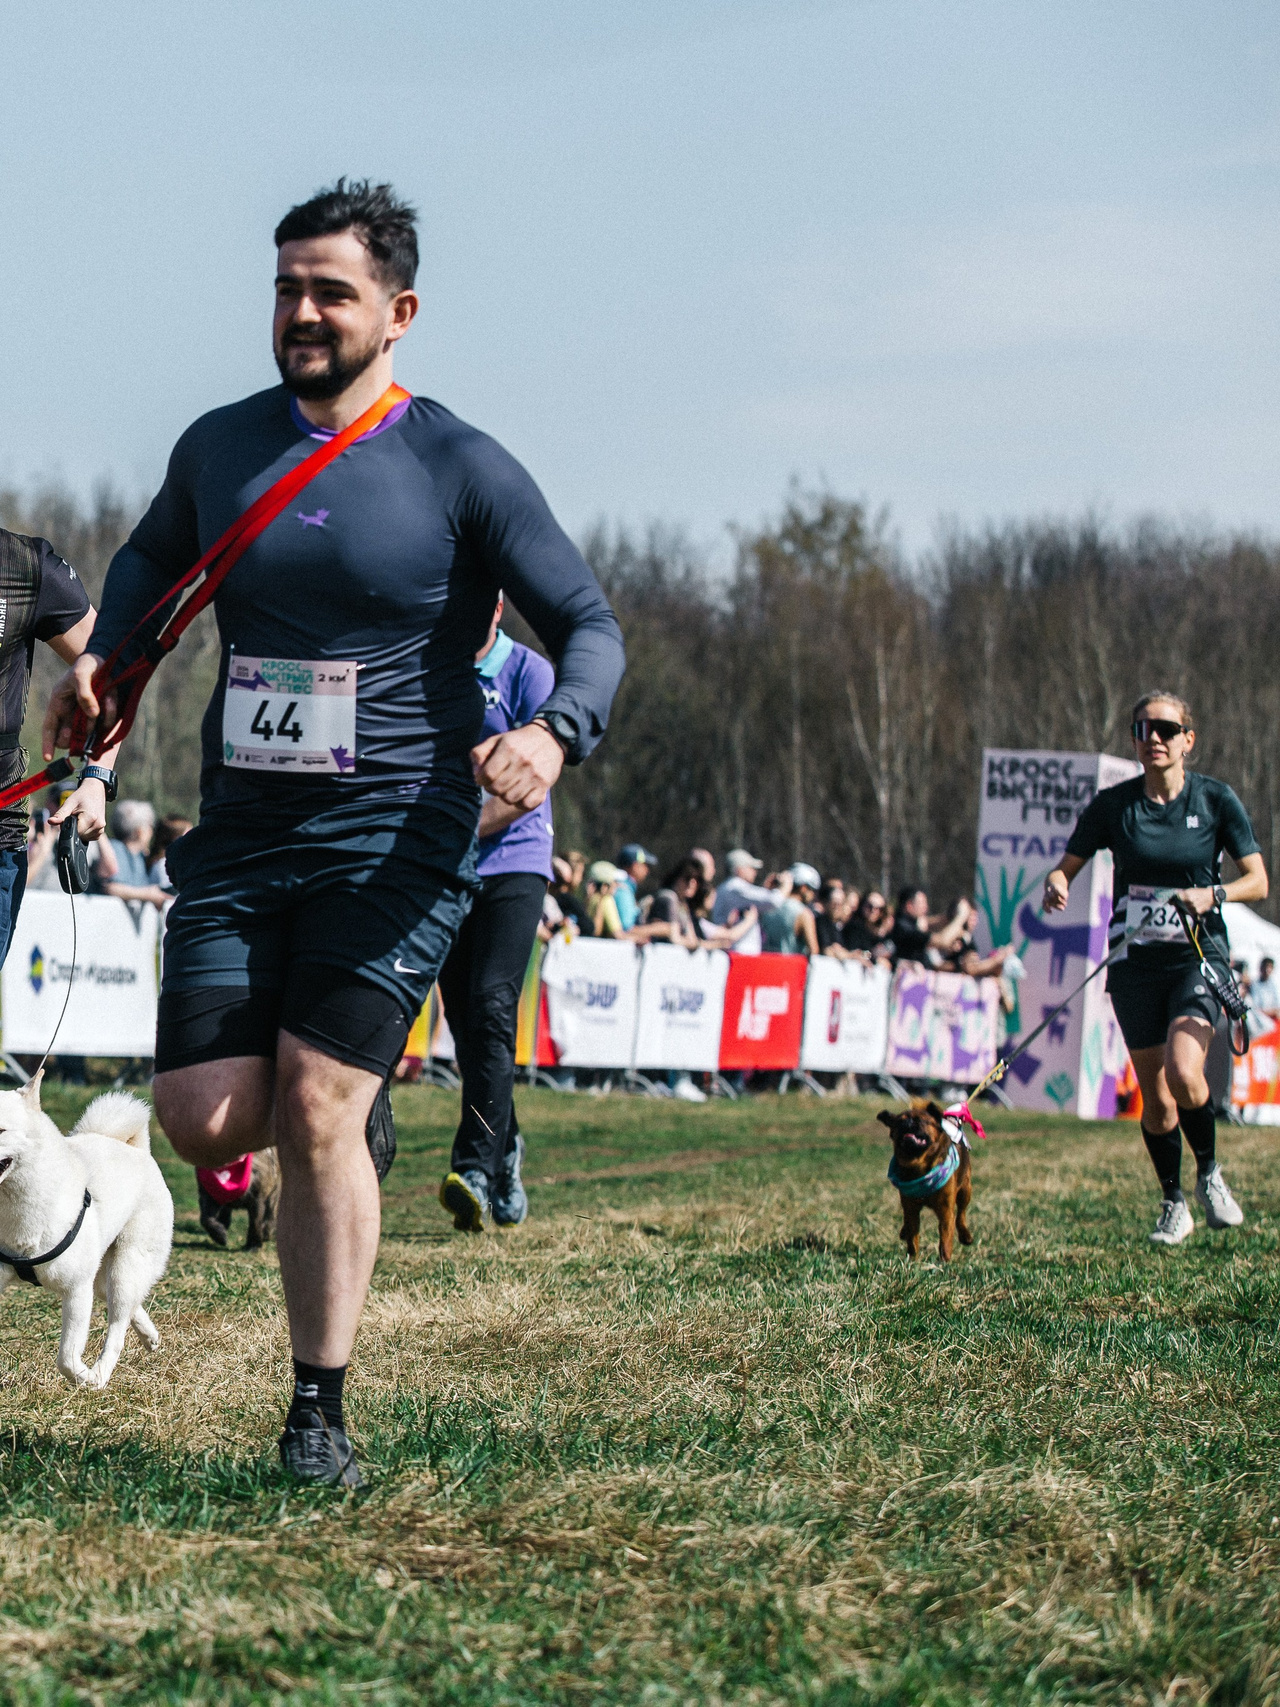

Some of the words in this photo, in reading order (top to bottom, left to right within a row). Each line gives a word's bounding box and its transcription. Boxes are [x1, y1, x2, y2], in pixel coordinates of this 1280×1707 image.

[318, 674, 326, 682] 2
[250, 700, 303, 743] 44
[988, 757, 1074, 781] КРОСС
[1141, 905, 1181, 928] 234
